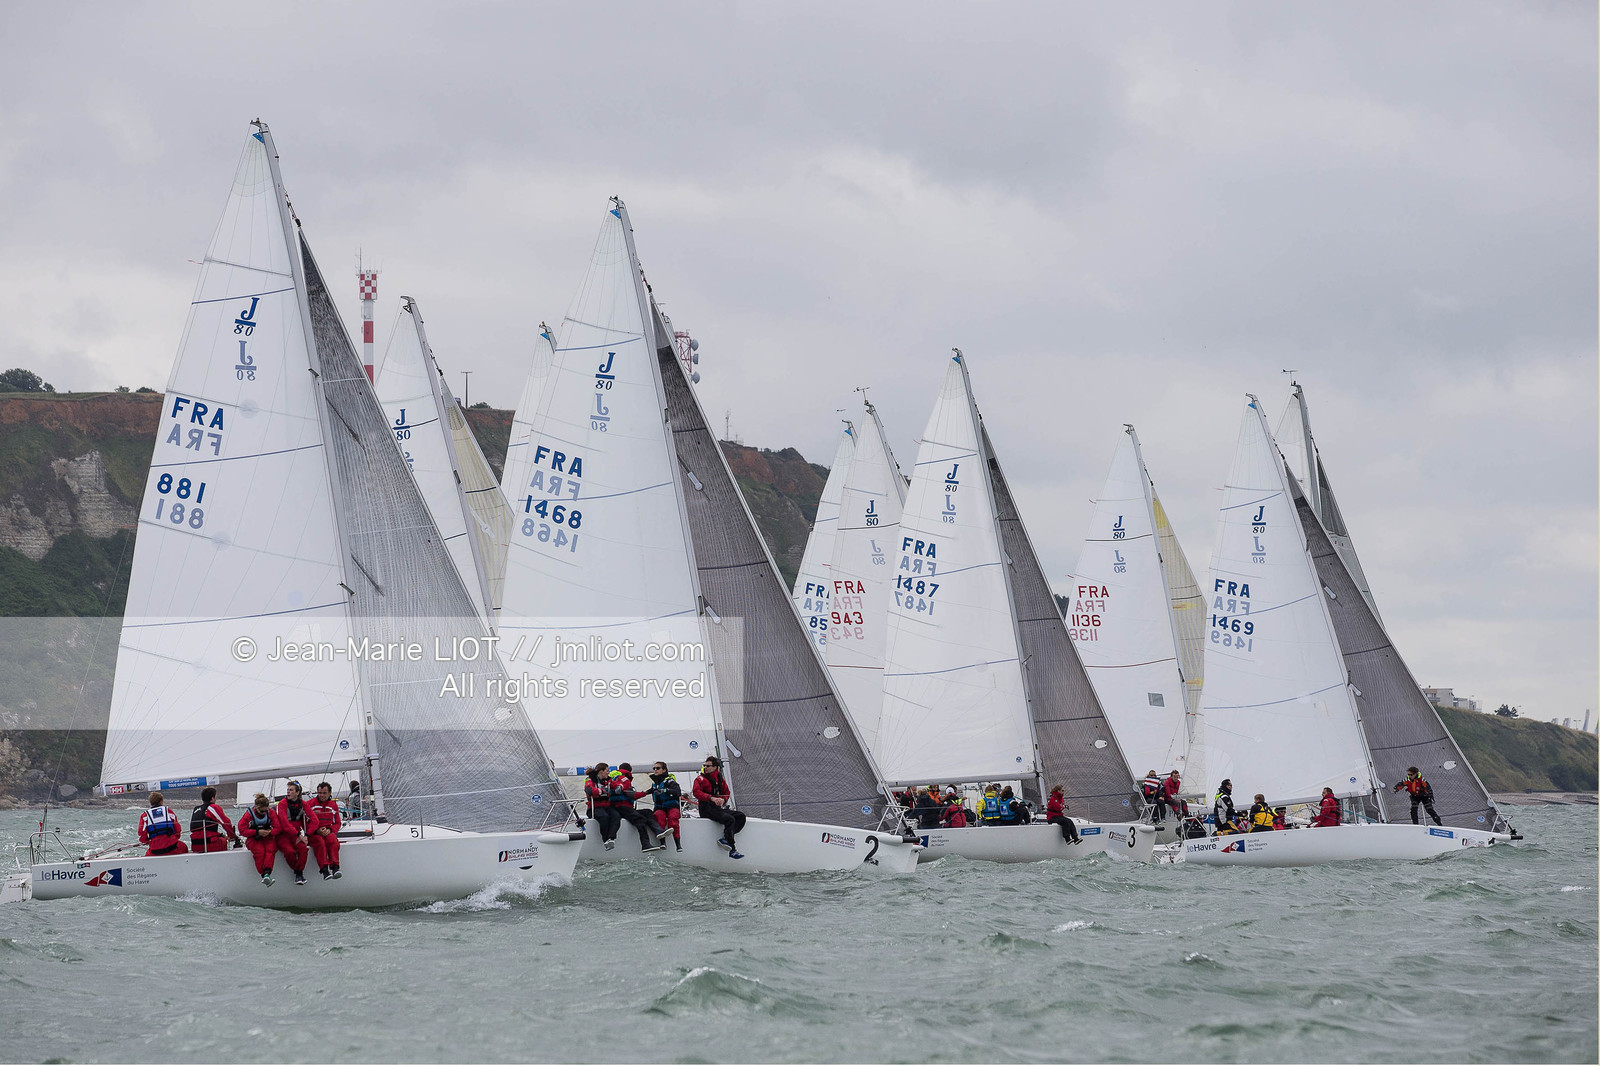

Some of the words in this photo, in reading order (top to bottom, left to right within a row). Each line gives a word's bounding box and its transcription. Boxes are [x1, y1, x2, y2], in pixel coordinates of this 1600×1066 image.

[240, 297, 260, 321] J
[233, 324, 254, 337] 80
[599, 352, 616, 373] J
[595, 379, 613, 391] 80
[170, 396, 225, 431] FRA
[395, 408, 407, 427] J
[396, 429, 411, 442] 80
[533, 445, 584, 478] FRA
[946, 463, 960, 480] J
[156, 472, 206, 505] 881
[944, 484, 958, 493] 80
[525, 494, 583, 530] 1468
[866, 500, 876, 515] J
[1253, 506, 1265, 522] J
[866, 517, 879, 527] 80
[1113, 515, 1123, 529] J
[1112, 531, 1126, 540] 80
[1252, 526, 1266, 534] 80
[901, 536, 937, 559] FRA
[833, 580, 866, 595] FRA
[896, 574, 940, 599] 1487
[1078, 585, 1110, 599] FRA
[1214, 578, 1251, 599] FRA
[809, 616, 829, 631] 85
[831, 611, 864, 626] 943
[1071, 614, 1102, 627] 1136
[1212, 614, 1255, 636] 1469
[410, 827, 420, 839] 5
[1128, 826, 1137, 849] 3
[508, 846, 539, 854] NORMANDY
[864, 835, 880, 866] 2
